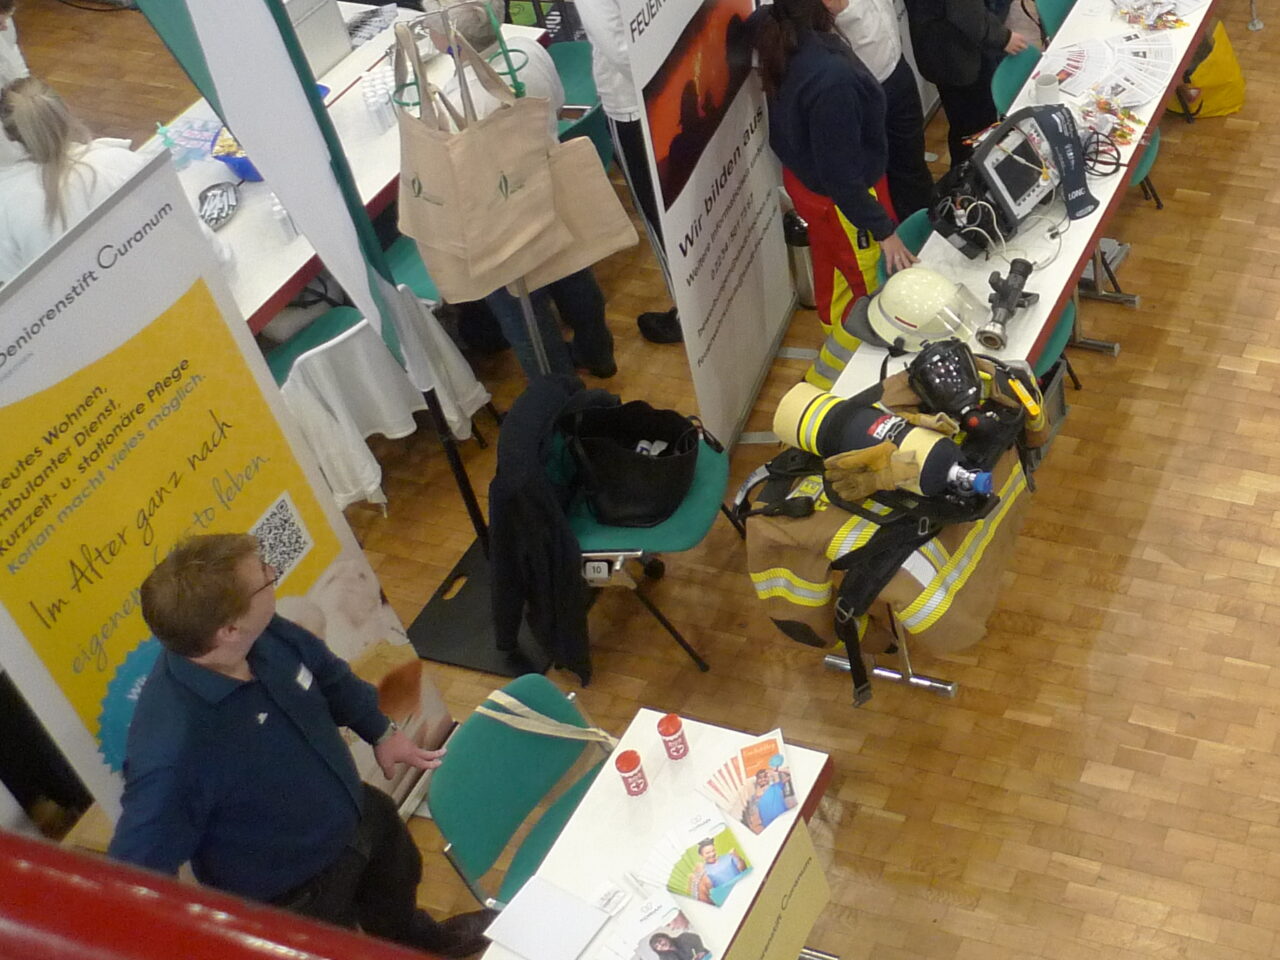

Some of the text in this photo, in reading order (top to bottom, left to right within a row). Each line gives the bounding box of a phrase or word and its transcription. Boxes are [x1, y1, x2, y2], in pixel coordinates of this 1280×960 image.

[97, 202, 173, 269] Curanum
[678, 105, 764, 259] Wir bilden aus
[0, 385, 107, 494] eutes Wohnen,
[0, 446, 73, 527] mbulanter
[73, 398, 122, 448] Dienst,
[57, 469, 107, 524] macht
[107, 429, 146, 472] vieles
[146, 373, 207, 431] möglich.
[60, 476, 77, 491] u.
[77, 401, 147, 474] stationäre
[146, 358, 190, 404] Pflege
[211, 453, 271, 511] leben.
[29, 596, 70, 630] Im
[136, 468, 185, 547] ganz
[186, 408, 233, 471] nach
